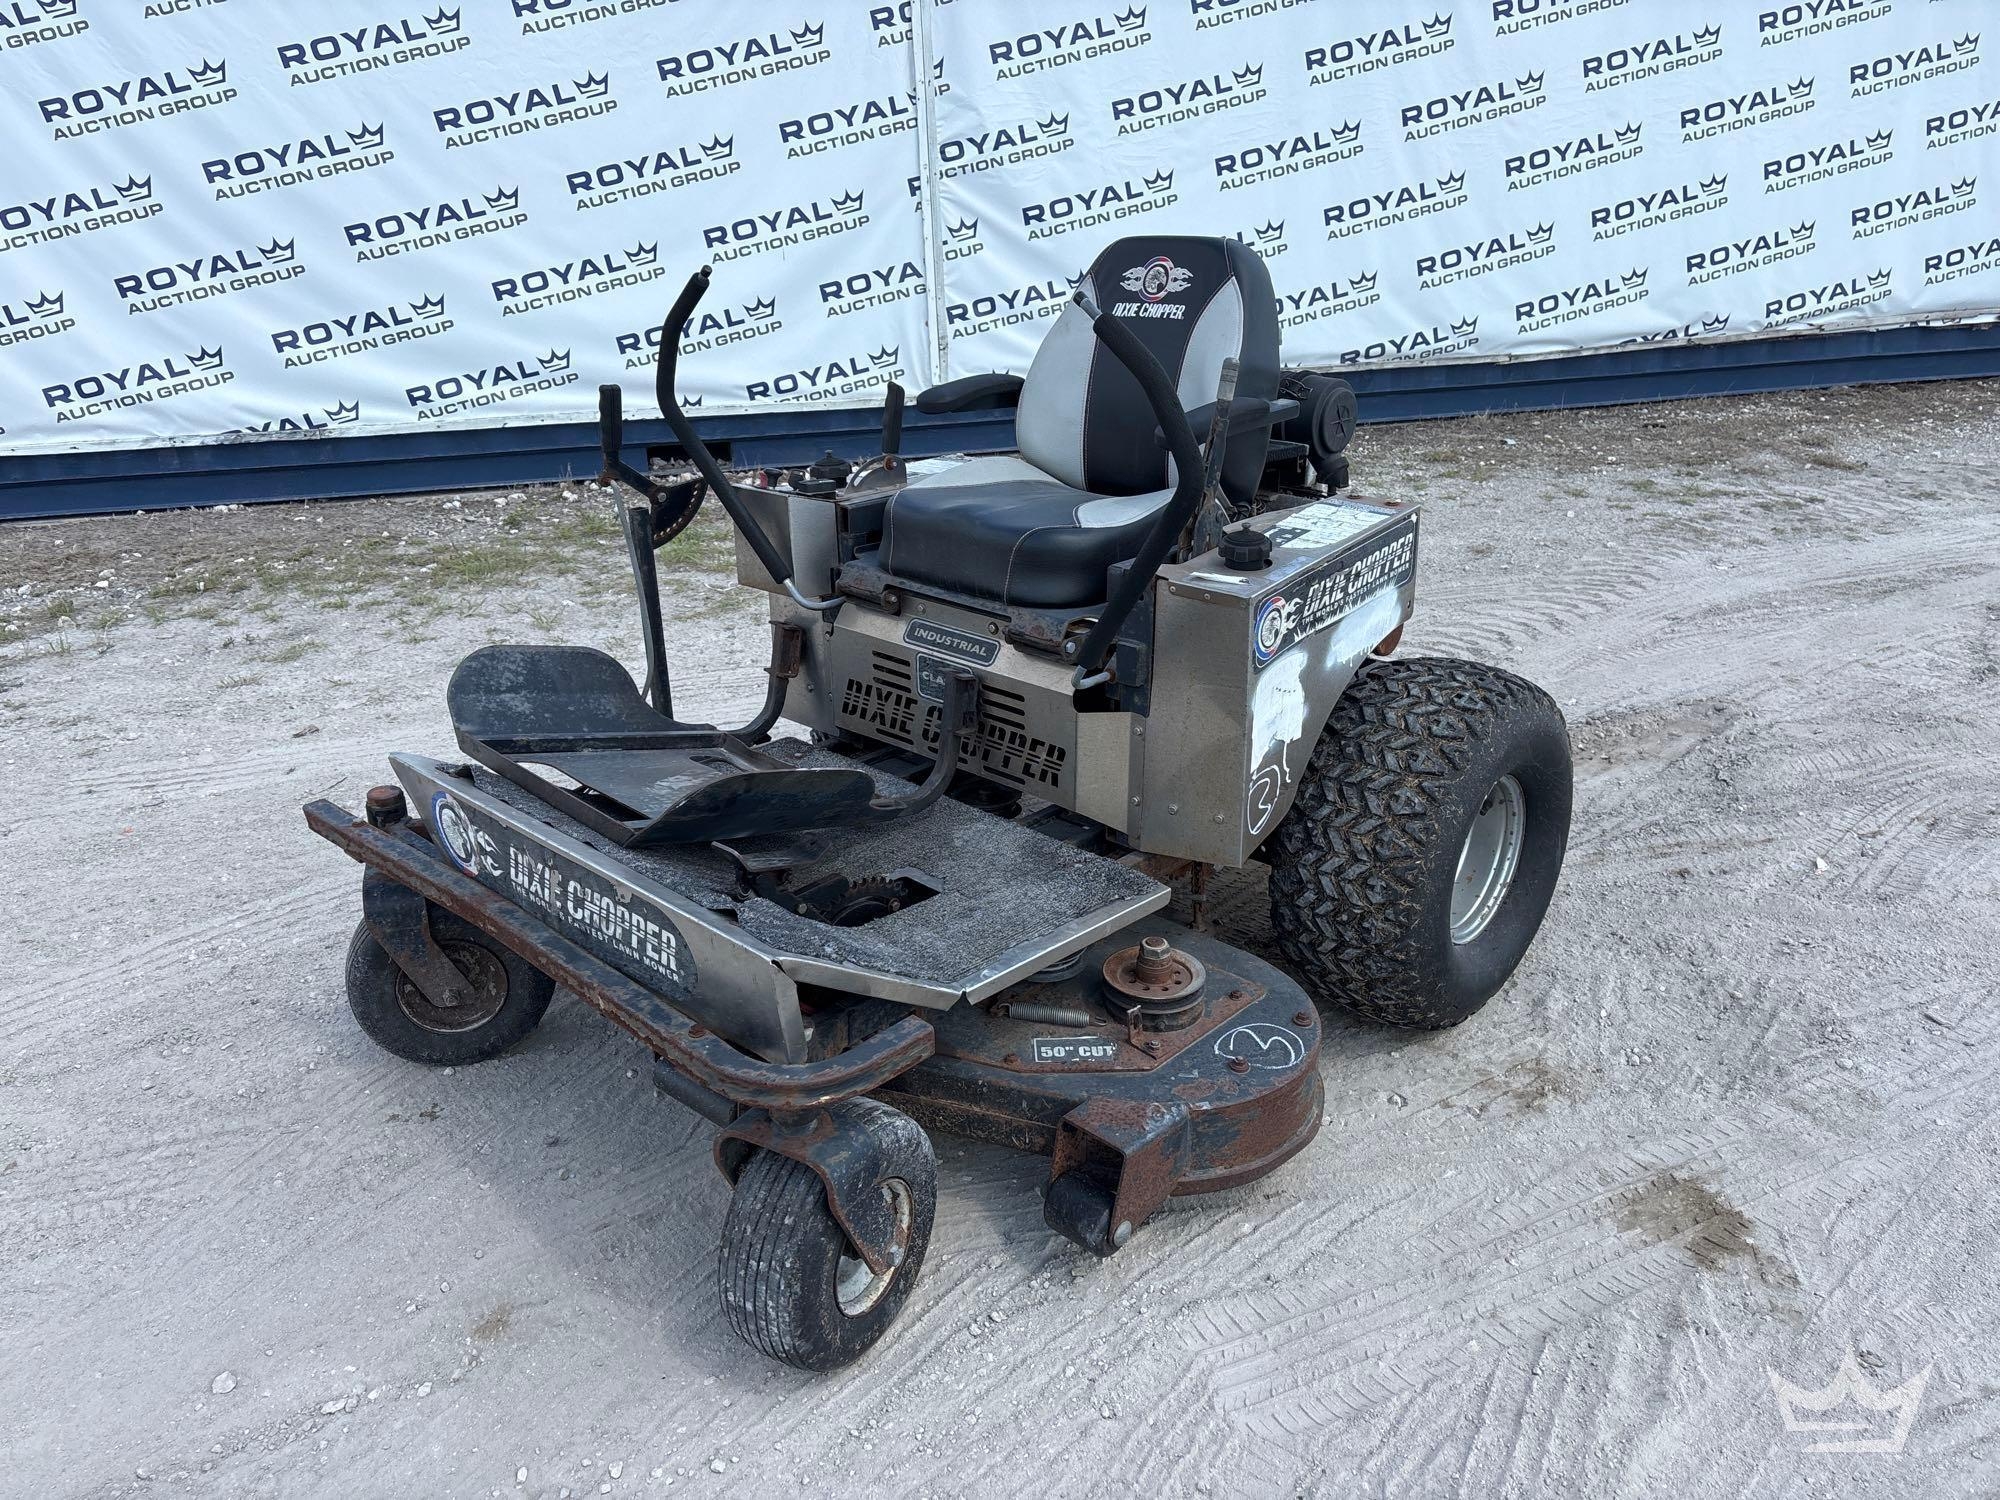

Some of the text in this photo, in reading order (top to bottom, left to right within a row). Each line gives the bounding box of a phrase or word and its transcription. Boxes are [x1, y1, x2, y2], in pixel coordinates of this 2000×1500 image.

[6, 20, 89, 48] GROUP
[522, 4, 617, 36] AUCTION
[1196, 0, 1277, 31] AUCTION
[1495, 8, 1572, 37] AUCTION
[1761, 5, 1891, 47] AUCTION GROUP
[277, 19, 427, 69] ROYAL
[291, 36, 471, 87] AUCTION GROUP
[656, 34, 792, 82] ROYAL
[989, 18, 1116, 65] ROYAL
[996, 33, 1151, 81] AUCTION GROUP
[1305, 25, 1422, 71] ROYAL
[1309, 39, 1454, 87] AUCTION GROUP
[1583, 35, 1692, 78] ROYAL
[1850, 43, 1952, 84] ROYAL
[666, 50, 831, 99] AUCTION GROUP
[1585, 48, 1723, 93] AUCTION GROUP
[1851, 56, 1980, 99] AUCTION GROUP
[38, 72, 192, 123] ROYAL
[54, 88, 237, 141] AUCTION GROUP
[433, 84, 576, 132] ROYAL
[779, 96, 909, 143] ROYAL
[1111, 75, 1233, 121] ROYAL
[1118, 89, 1266, 136] AUCTION GROUP
[1401, 82, 1515, 127] ROYAL
[1404, 95, 1546, 142] AUCTION GROUP
[1680, 87, 1787, 129] ROYAL
[446, 100, 617, 150] AUCTION GROUP
[787, 128, 875, 159] AUCTION
[939, 124, 1038, 163] OYAL
[1682, 100, 1815, 144] AUCTION GROUP
[1927, 123, 1997, 150] AUCTION
[201, 135, 351, 184] ROYAL
[566, 147, 702, 195] ROYAL
[1008, 138, 1074, 164] GROUP
[1215, 132, 1331, 177] ROYAL
[1219, 145, 1364, 192] AUCTION GROUP
[1505, 133, 1614, 177] ROYAL
[1508, 146, 1643, 192] AUCTION GROUP
[1764, 139, 1864, 180] ROYAL
[1765, 152, 1893, 194] AUCTION GROUP
[216, 151, 394, 201] AUCTION GROUP
[577, 161, 741, 211] AUCTION GROUP
[0, 188, 119, 230] OYAL
[343, 198, 487, 246] ROYAL
[703, 202, 833, 249] ROYAL
[1022, 181, 1144, 226] ROYAL
[1028, 194, 1178, 241] AUCTION GROUP
[1323, 182, 1437, 227] ROYAL
[1327, 195, 1468, 241] AUCTION GROUP
[1591, 185, 1699, 228] ROYAL
[1593, 197, 1728, 242] AUCTION GROUP
[1851, 187, 1949, 227] ROYAL
[1852, 198, 1976, 240] AUCTION GROUP
[0, 203, 163, 252] UCTION GROUP
[357, 213, 528, 263] AUCTION GROUP
[712, 215, 870, 264] AUCTION GROUP
[113, 250, 263, 299] ROYAL
[1416, 233, 1526, 277] ROYAL
[1419, 245, 1555, 291] AUCTION GROUP
[1686, 231, 1789, 273] ROYAL
[1688, 242, 1816, 287] AUCTION GROUP
[1924, 261, 1991, 286] AUCTION
[1925, 238, 2000, 274] ROYA
[129, 265, 306, 315] AUCTION GROUP
[491, 254, 627, 301] ROYAL
[502, 267, 665, 317] AUCTION GROUP
[819, 261, 924, 303] ROYA
[1765, 278, 1866, 319] ROYAL
[827, 287, 910, 318] AUCTION
[945, 281, 1066, 325] ROYAL
[1112, 303, 1185, 320] DIXIE CHOPPER
[1321, 293, 1380, 317] GROUP
[1515, 279, 1620, 322] ROYAL
[1518, 306, 1589, 335] AUCTION
[1593, 289, 1649, 313] GROUP
[1763, 289, 1893, 330] AUCTION GROUP
[0, 318, 75, 346] GROUP
[271, 306, 413, 354] ROYAL
[285, 320, 454, 369] AUCTION GROUP
[625, 321, 782, 369] AUCION GROUP
[952, 310, 1034, 340] AUCTION
[1340, 327, 1449, 364] ROYAL
[1419, 337, 1479, 359] GROUP
[41, 358, 191, 408] ROYAL
[57, 371, 234, 423] AUCTION GROUP
[405, 361, 540, 407] ROYAL
[418, 373, 579, 421] AUCTION GROUP
[746, 357, 870, 401] ROYAL
[841, 369, 905, 394] GROUP
[1348, 533, 1413, 594] CHOPPER
[914, 627, 987, 656] INDUSTRIAL
[842, 678, 918, 734] DIXIE
[567, 880, 677, 971] CHOPPER
[613, 939, 640, 960] LAWN
[643, 957, 680, 983] MOWER
[1040, 1045, 1113, 1058] 50" CUT
